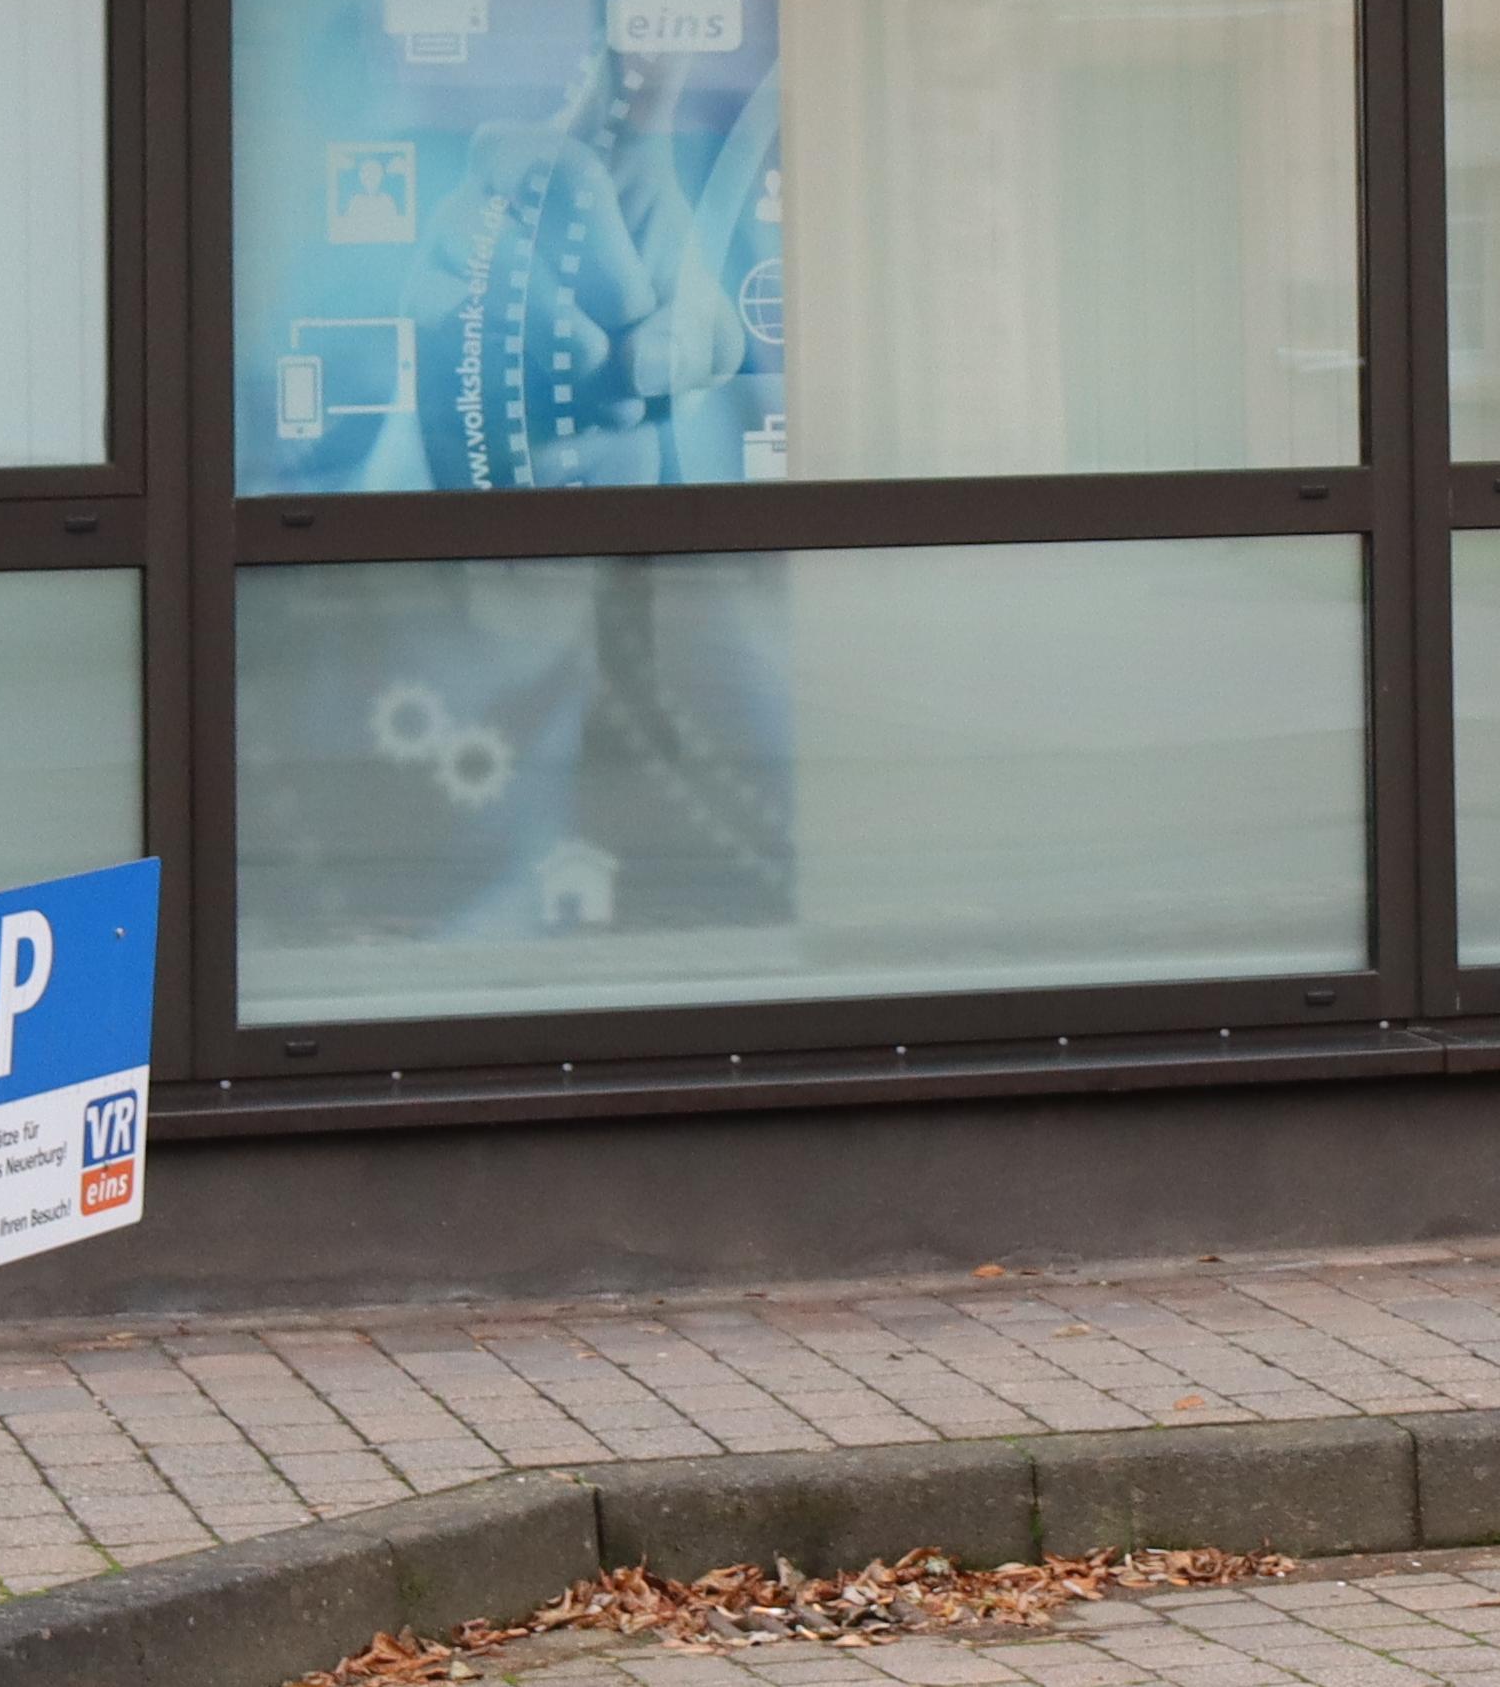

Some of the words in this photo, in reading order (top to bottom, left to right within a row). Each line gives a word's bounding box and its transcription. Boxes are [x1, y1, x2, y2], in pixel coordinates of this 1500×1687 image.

[626, 6, 725, 40] eins
[23, 1121, 40, 1142] für
[86, 1096, 135, 1160] VR
[5, 1141, 67, 1175] Neuerburg!
[86, 1172, 129, 1206] eins
[0, 1215, 28, 1236] Ihren
[30, 1198, 72, 1227] Besuch!
